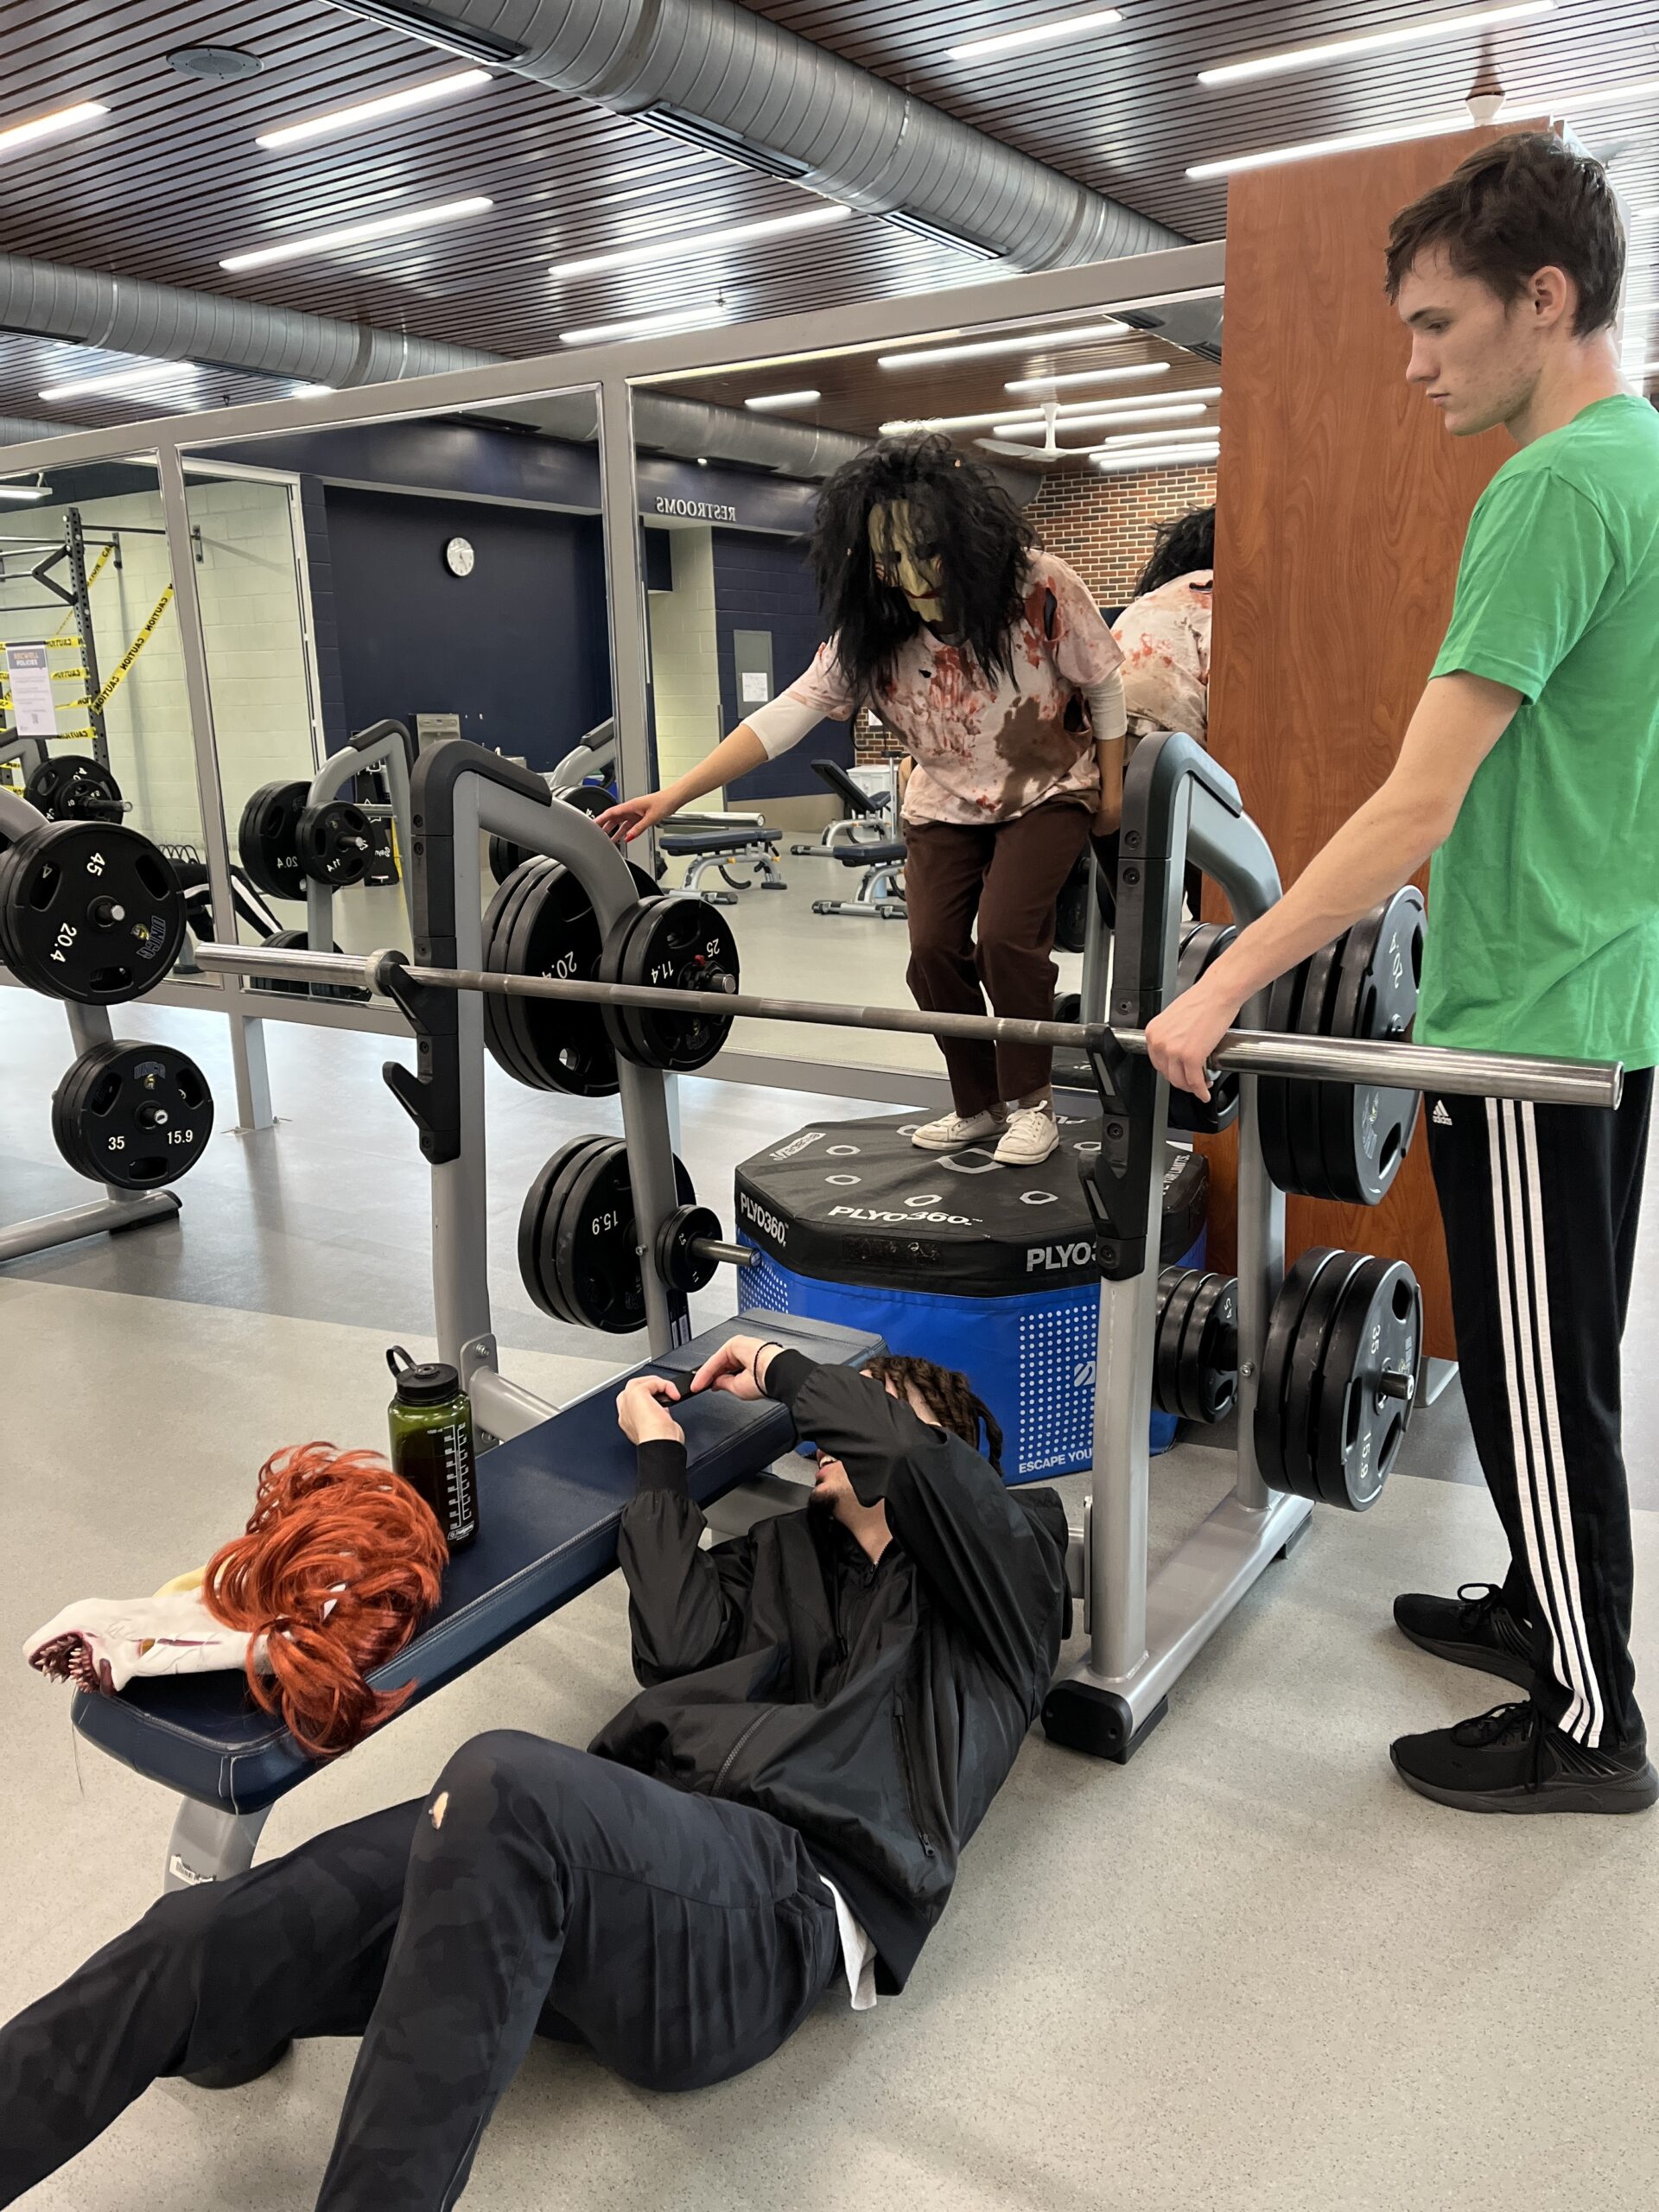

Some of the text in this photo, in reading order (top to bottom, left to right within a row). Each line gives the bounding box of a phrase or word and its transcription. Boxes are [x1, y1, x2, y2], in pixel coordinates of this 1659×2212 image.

[86, 852, 105, 876] 45
[50, 922, 78, 963] 20.4
[707, 938, 721, 958] 25
[650, 960, 675, 984] 11.4
[1389, 931, 1404, 989] 20.4
[1433, 1115, 1452, 1126] adidas
[108, 1136, 125, 1151] 35
[167, 1129, 194, 1145] 15.9
[591, 1210, 620, 1236] 15.9
[1370, 1324, 1382, 1355] 35
[1019, 1454, 1066, 1474] ESCAPE
[1360, 1430, 1372, 1479] 15.9
